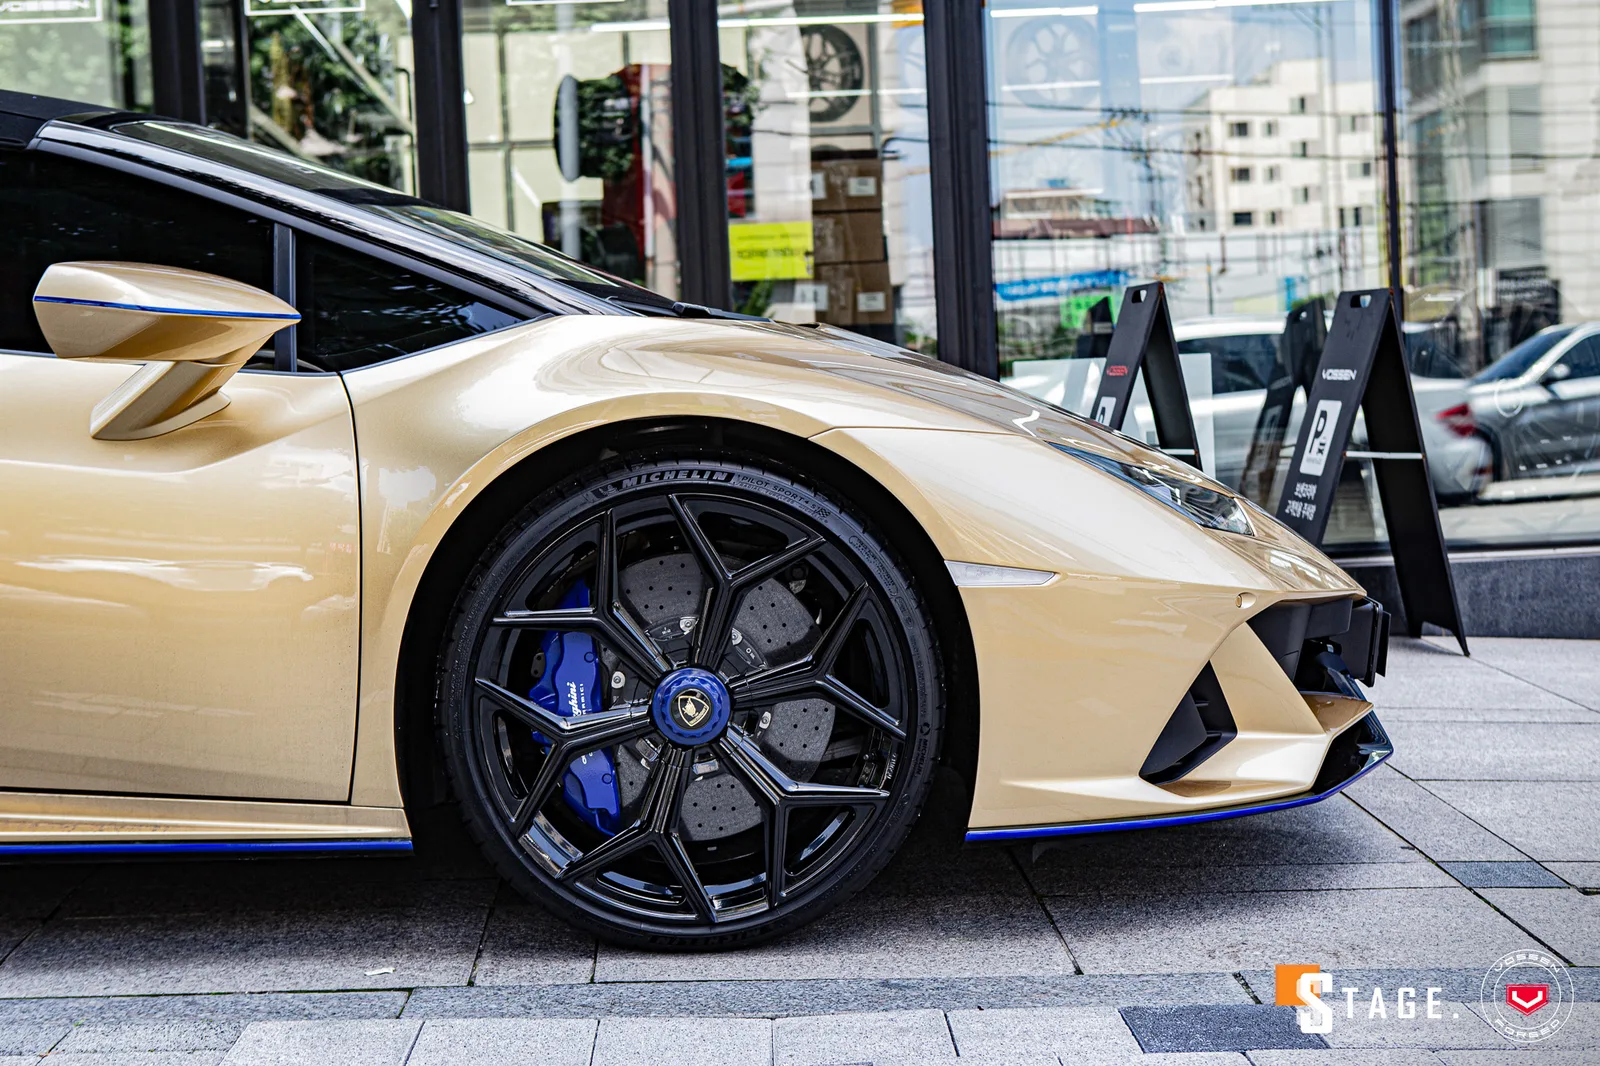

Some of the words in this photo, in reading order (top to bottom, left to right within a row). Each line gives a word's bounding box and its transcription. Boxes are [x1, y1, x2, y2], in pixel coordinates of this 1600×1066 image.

[1322, 368, 1357, 381] VOSSEN
[622, 470, 728, 490] MICHELIN
[741, 476, 769, 488] PILOT
[773, 483, 804, 503] SPORT
